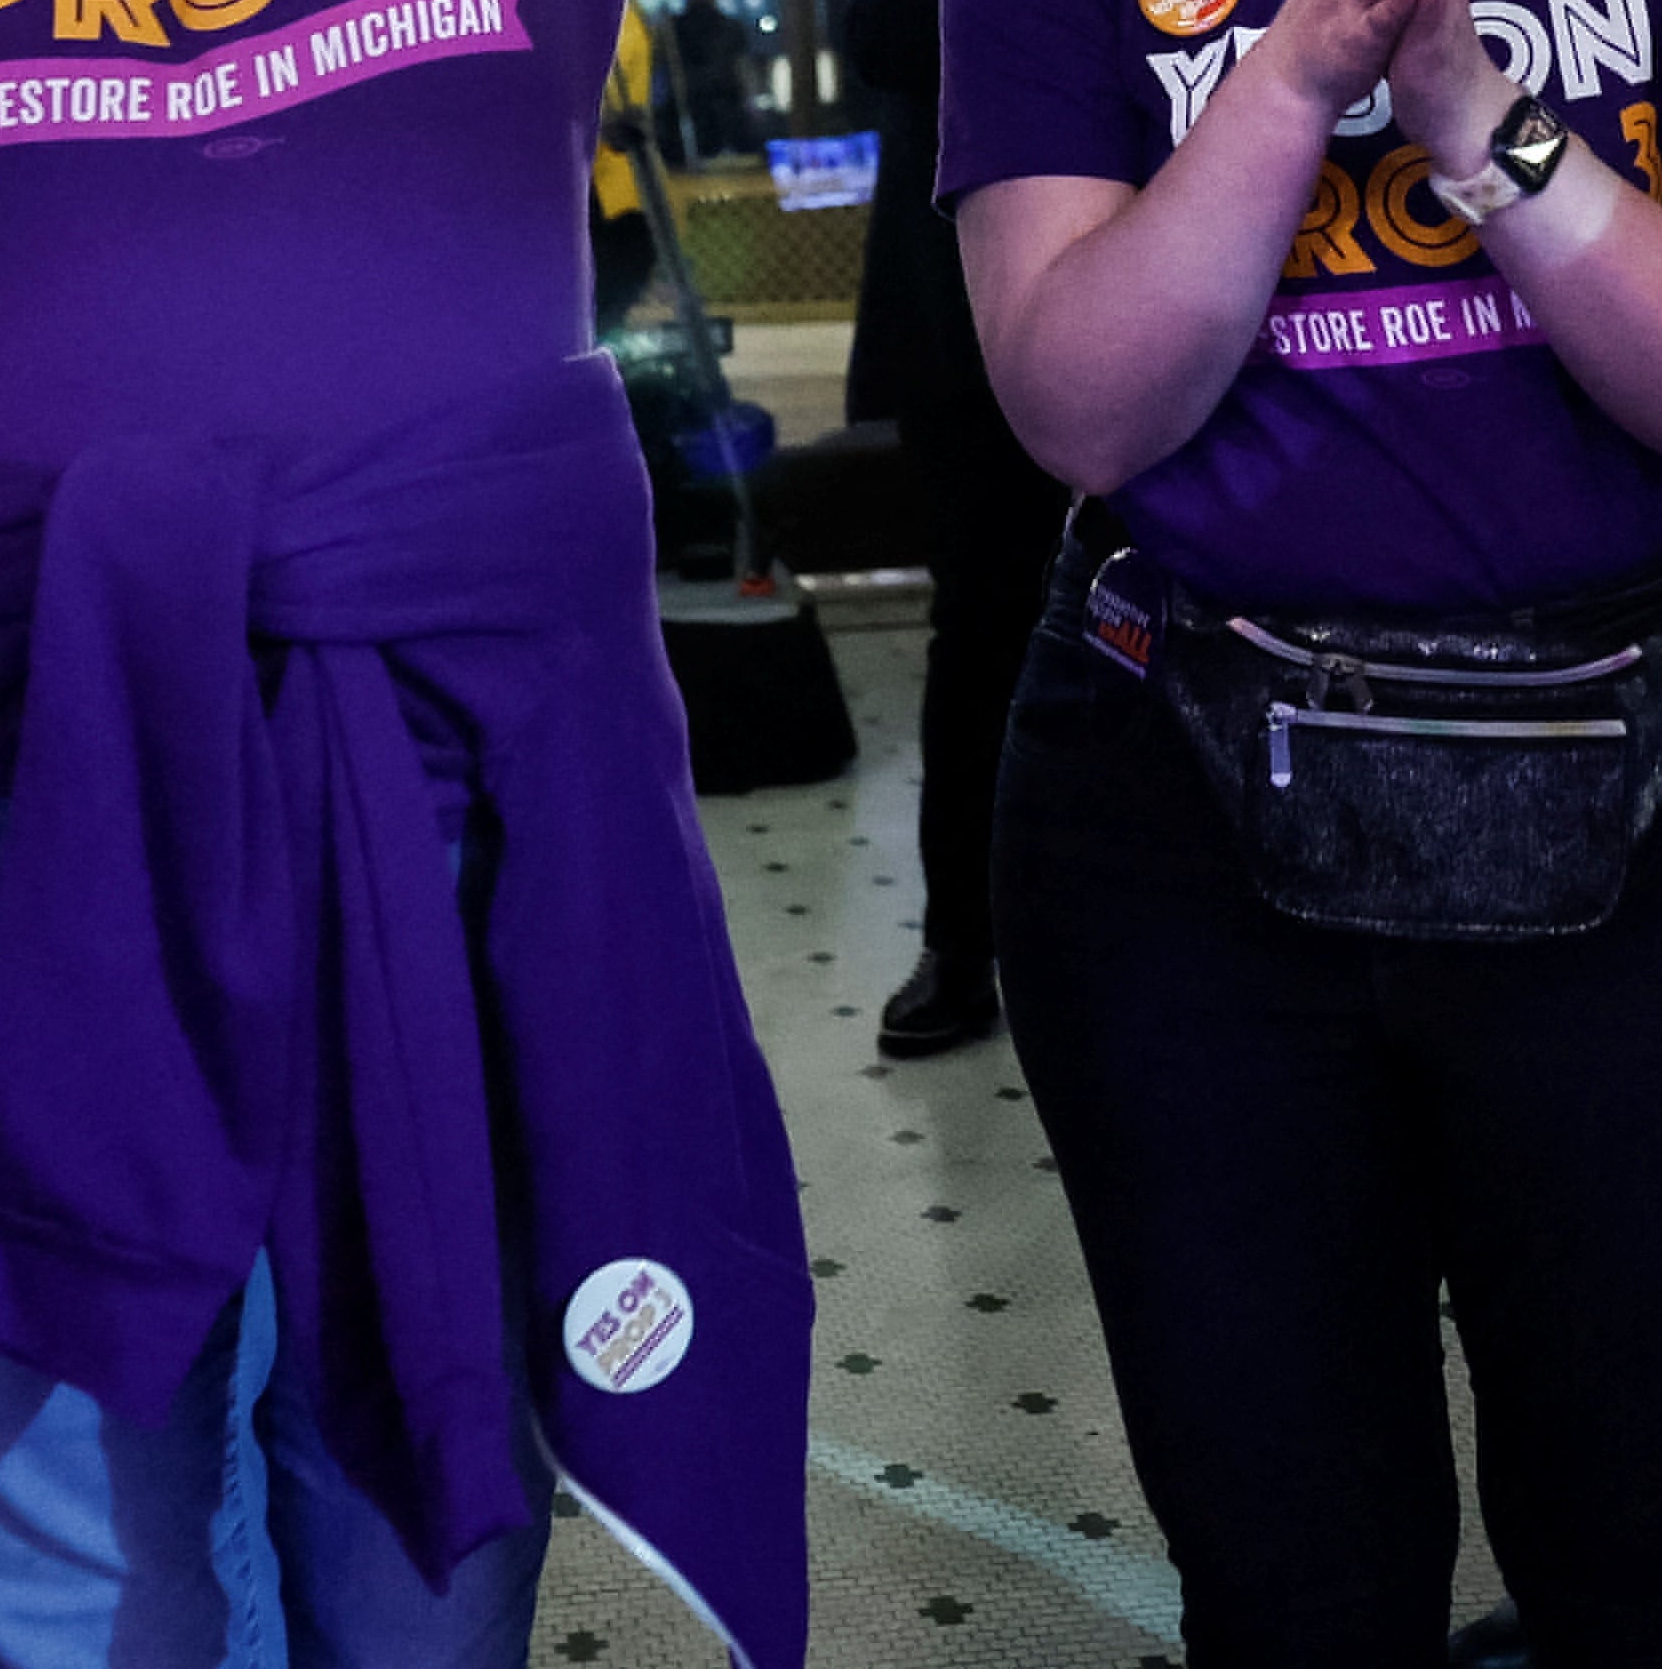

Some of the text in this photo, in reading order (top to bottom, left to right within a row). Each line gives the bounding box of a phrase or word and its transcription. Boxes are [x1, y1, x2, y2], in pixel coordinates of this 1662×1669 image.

[166, 62, 243, 124] ROE
[256, 46, 300, 99] IN
[1282, 144, 1480, 276] RO
[1268, 309, 1374, 356] STORE
[1378, 298, 1452, 348] ROE
[1460, 292, 1503, 337] IN
[574, 1309, 621, 1356] YES
